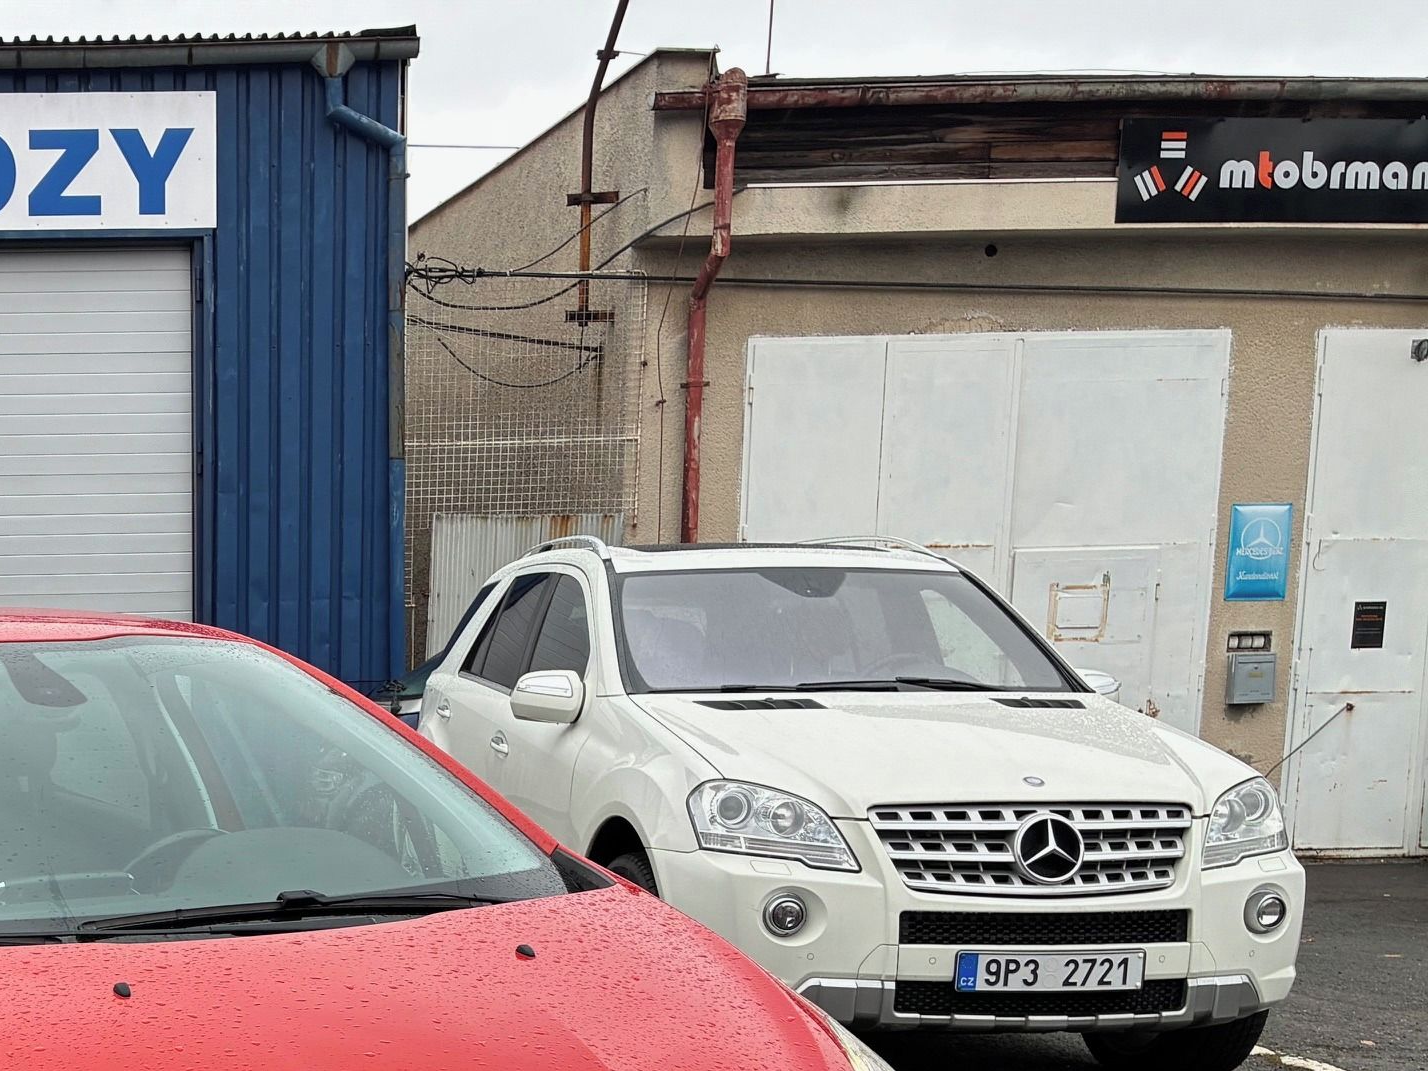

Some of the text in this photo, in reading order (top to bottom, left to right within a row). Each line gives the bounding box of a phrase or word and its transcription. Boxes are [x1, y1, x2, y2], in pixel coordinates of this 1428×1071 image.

[960, 976, 974, 987] CZ
[984, 957, 1129, 987] 9P3 2721
